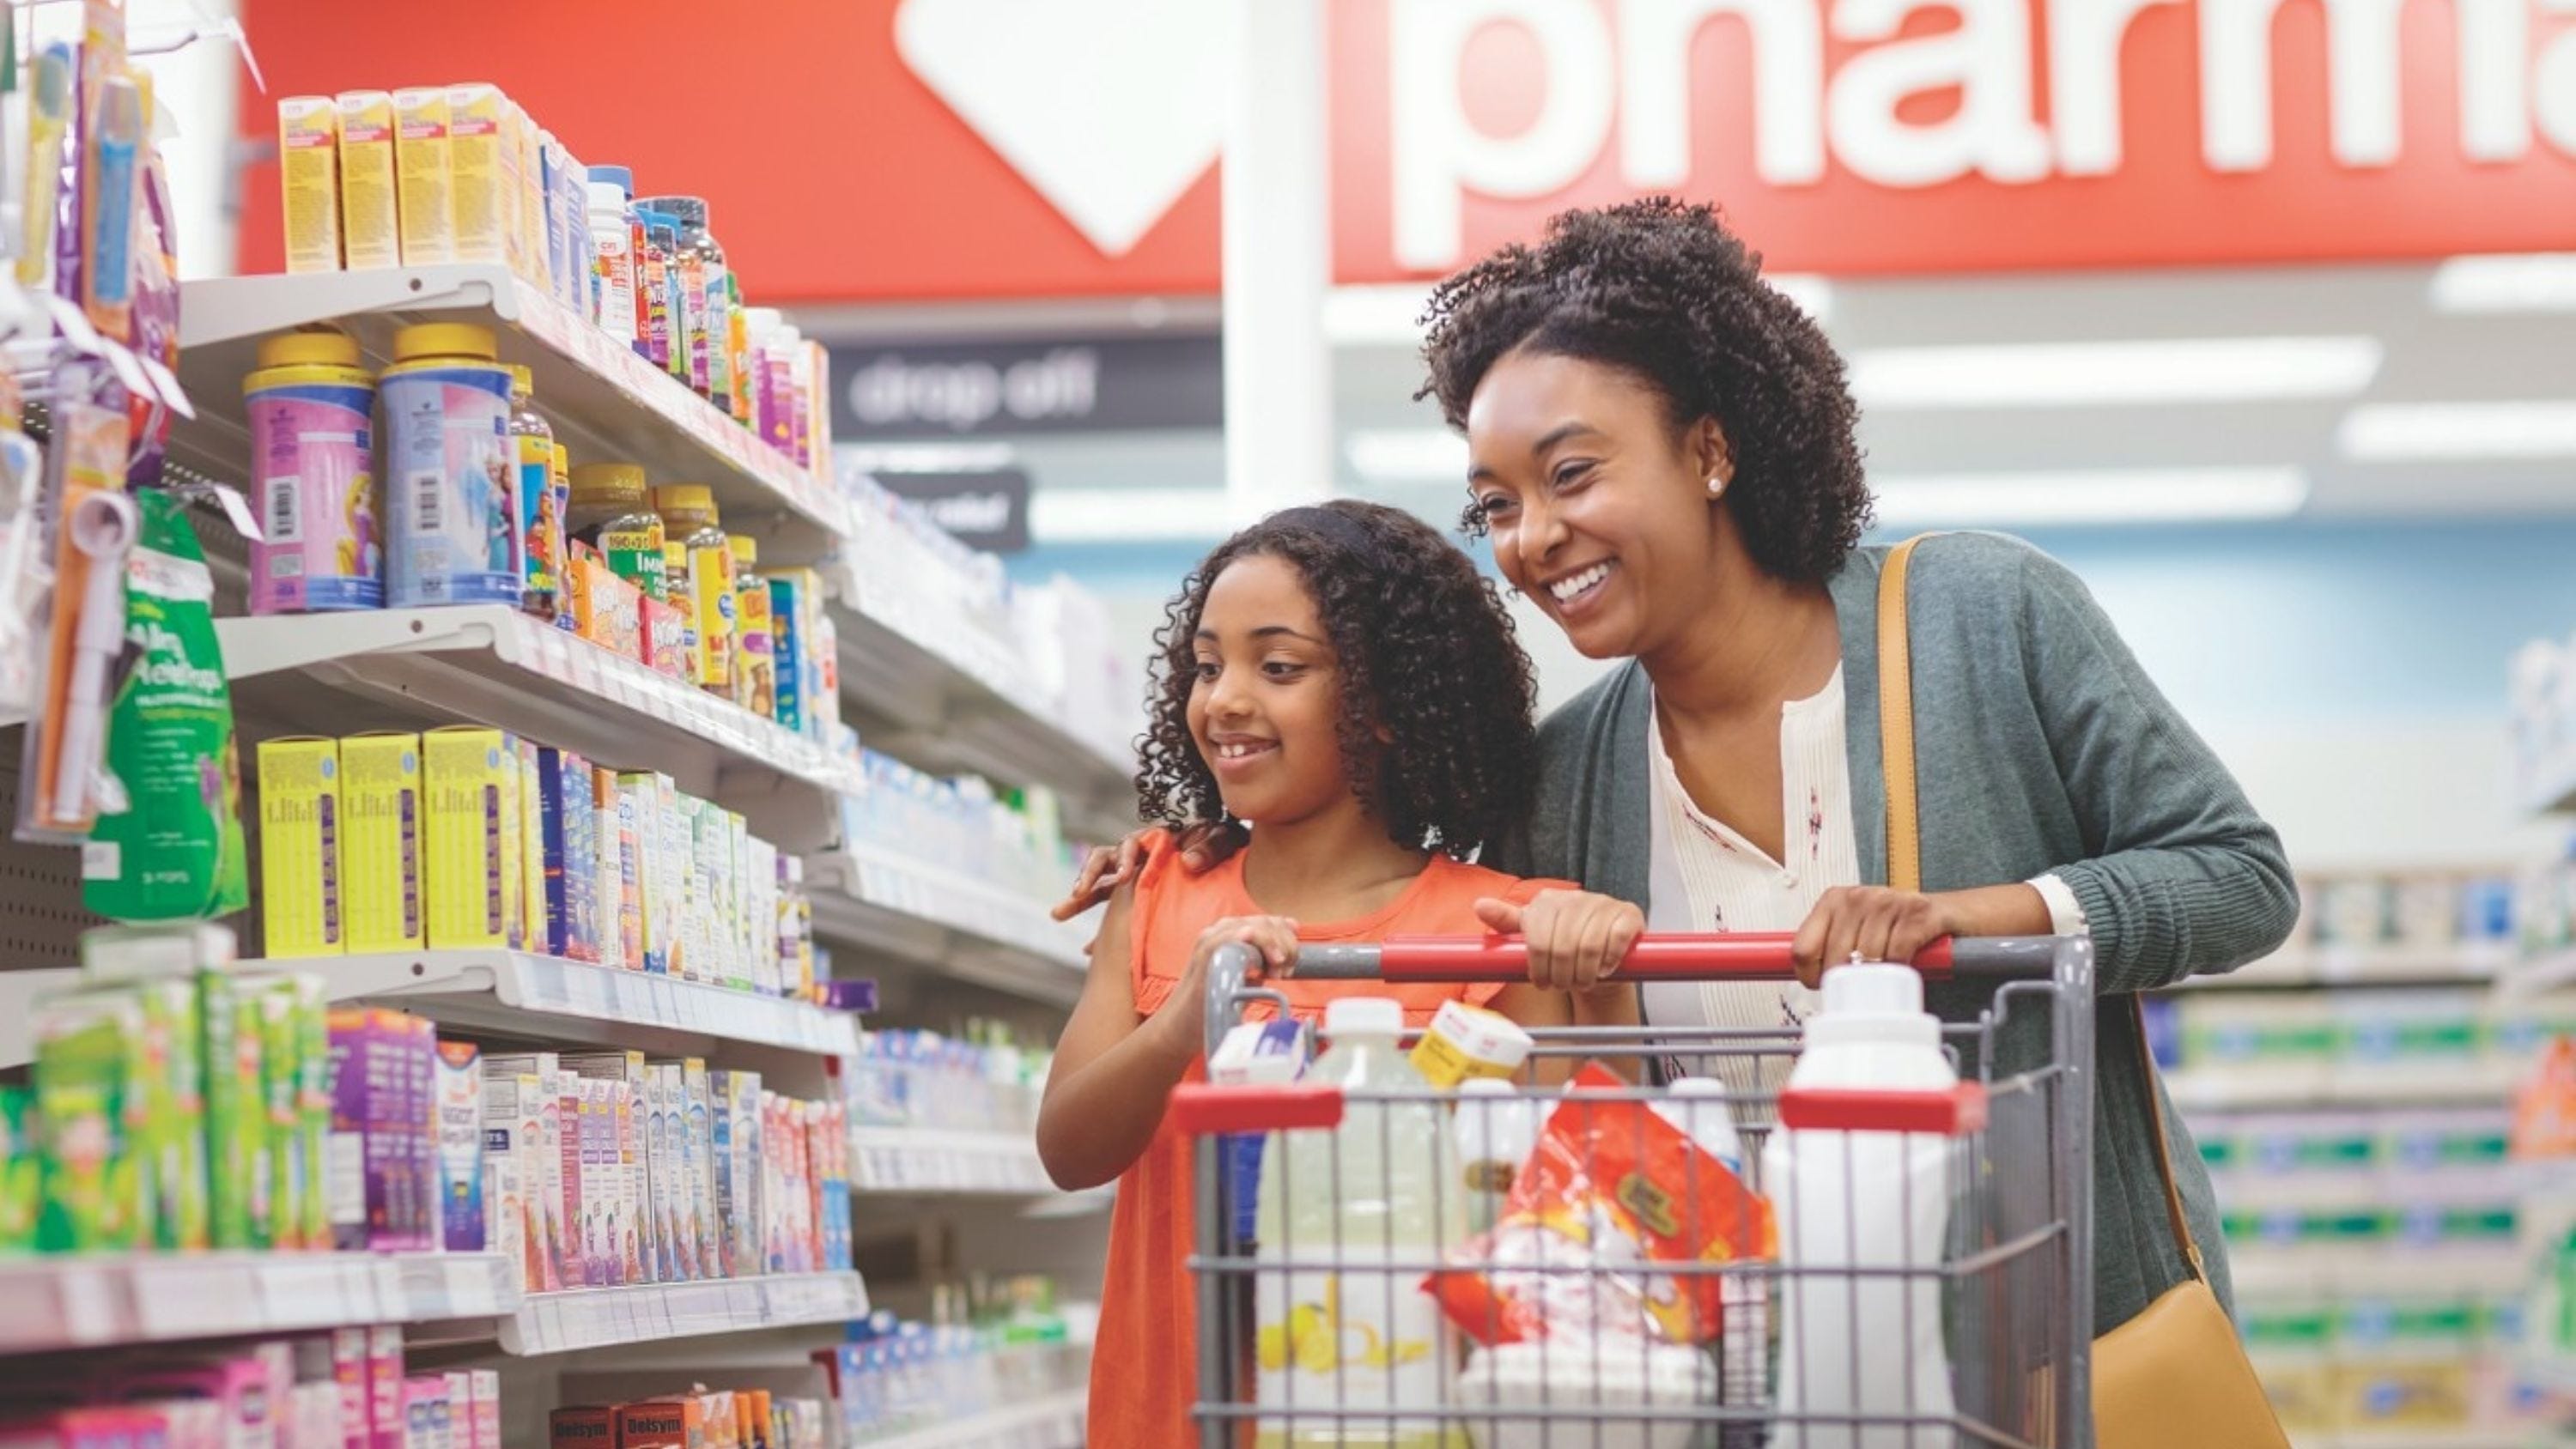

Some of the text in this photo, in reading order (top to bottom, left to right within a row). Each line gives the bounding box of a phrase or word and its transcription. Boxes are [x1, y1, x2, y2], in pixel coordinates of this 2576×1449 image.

[1389, 0, 2576, 270] pharm
[851, 346, 1098, 429] drop off
[555, 1420, 607, 1438] Delsym
[628, 1416, 682, 1434] Delsym
